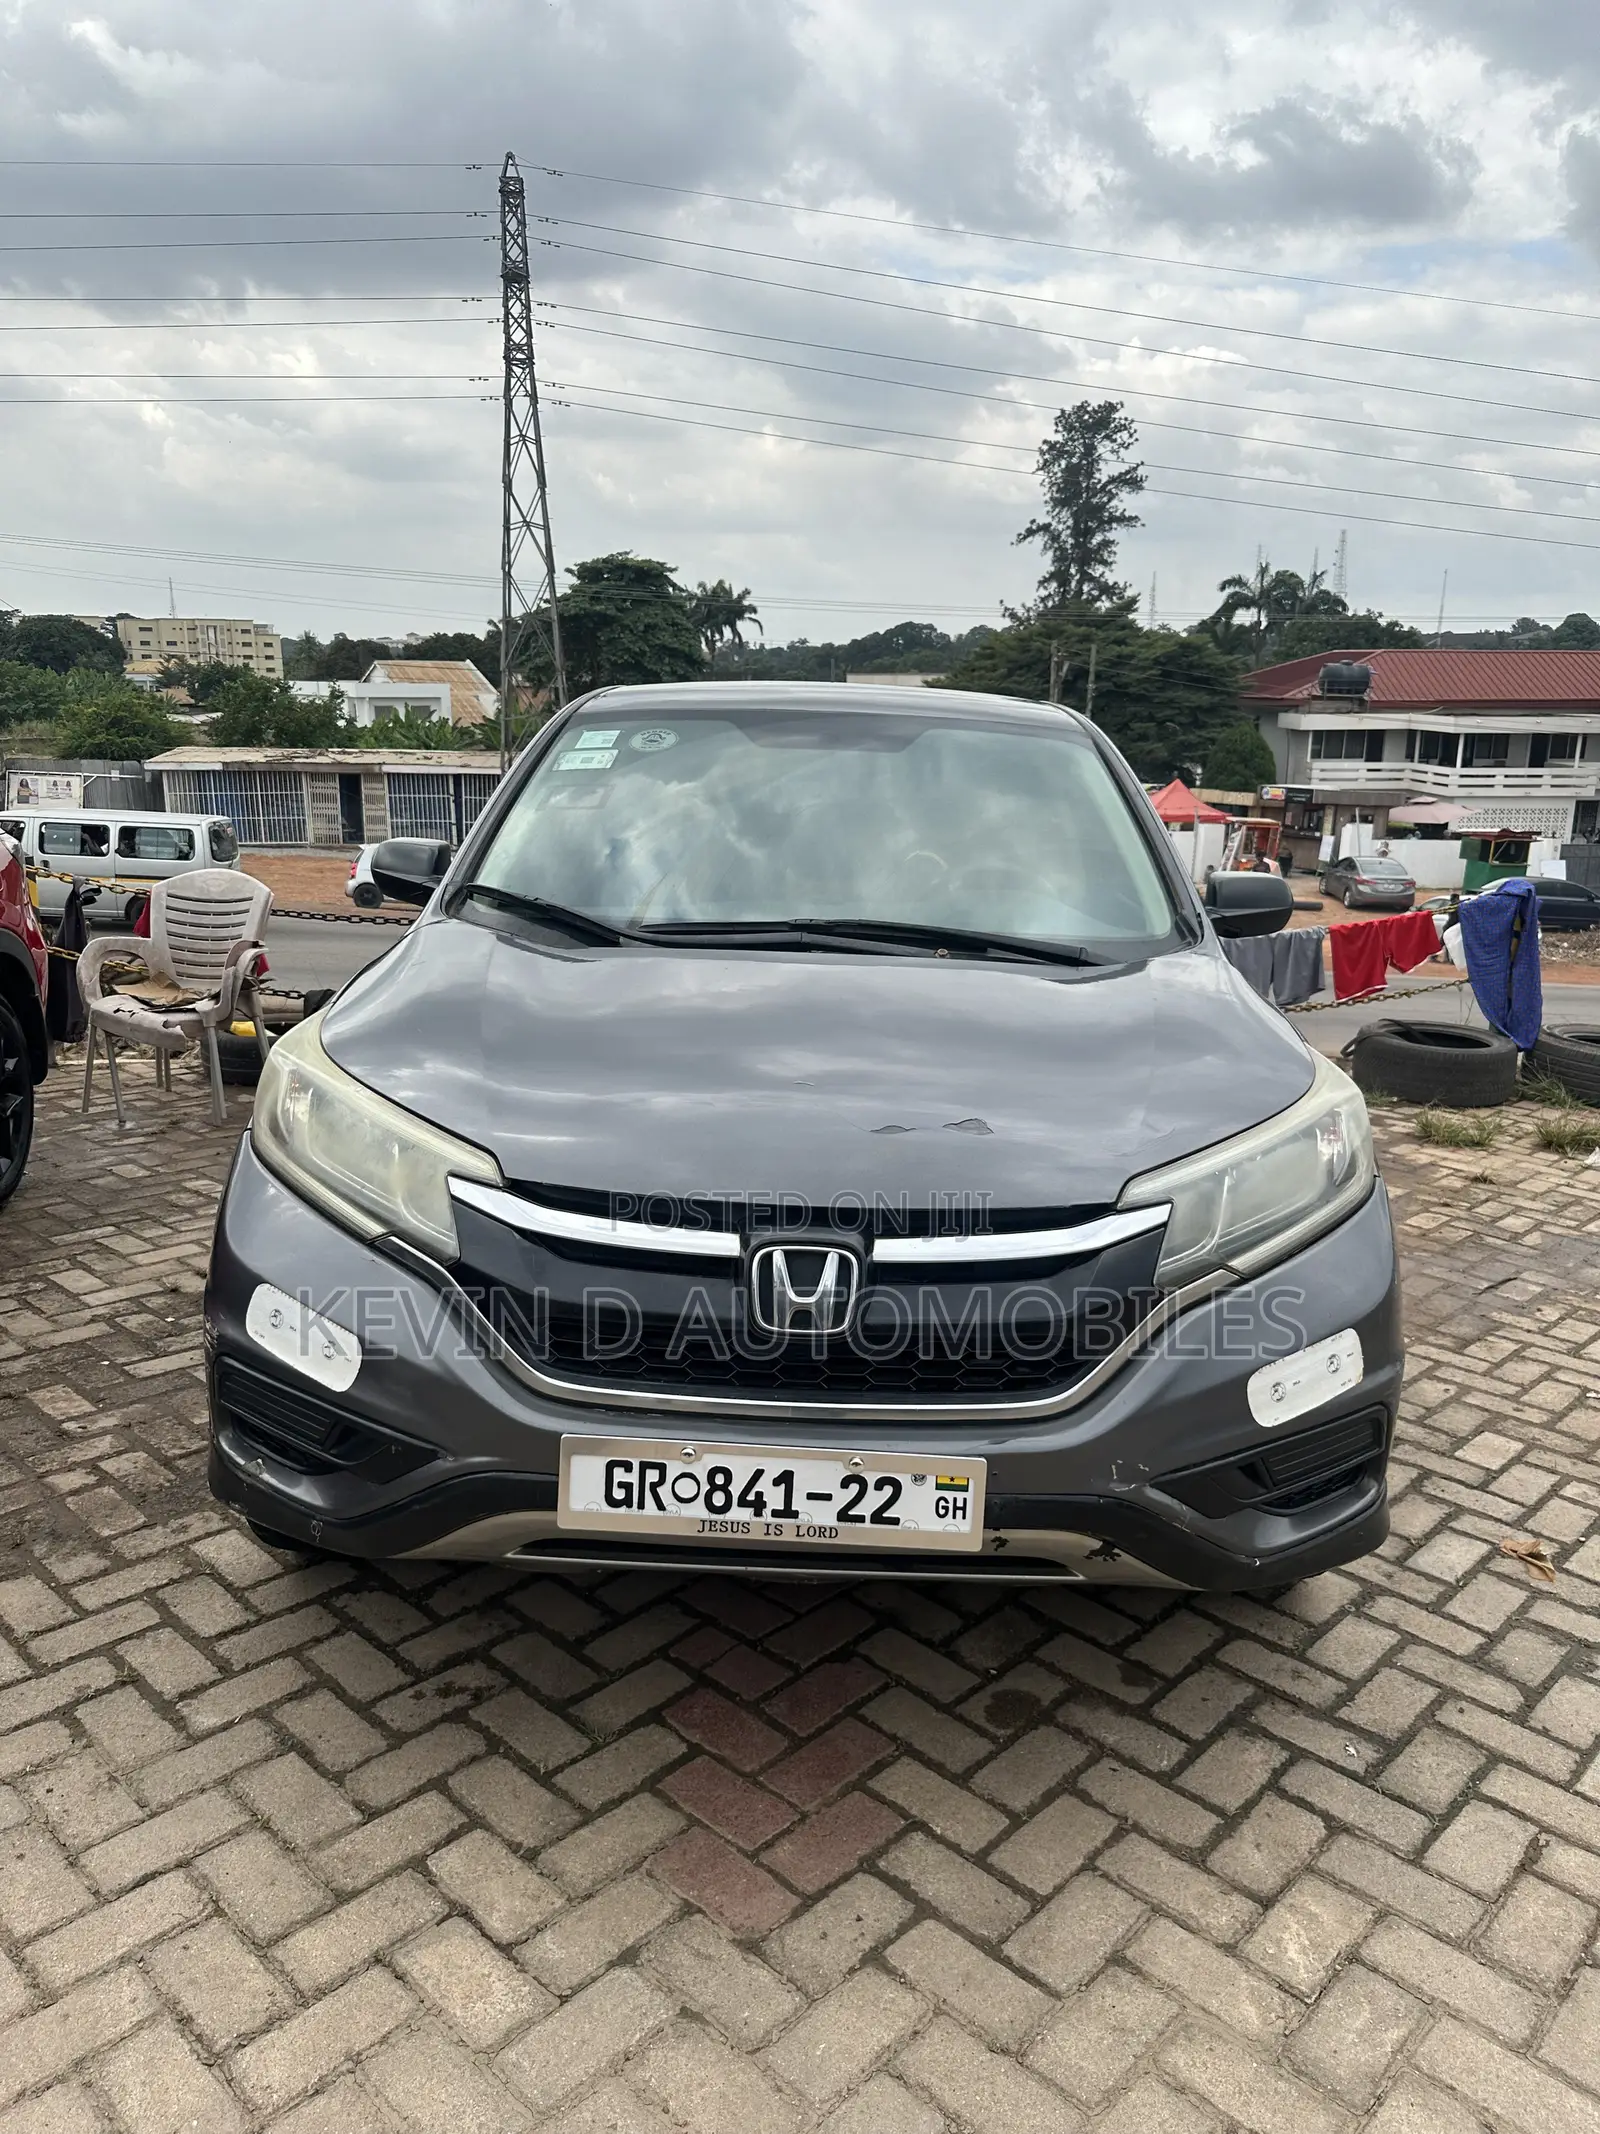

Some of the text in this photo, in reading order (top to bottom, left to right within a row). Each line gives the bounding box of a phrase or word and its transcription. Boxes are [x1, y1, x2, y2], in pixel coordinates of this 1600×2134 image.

[935, 1496, 967, 1520] GH
[697, 1519, 839, 1539] JESUS IS LORD
